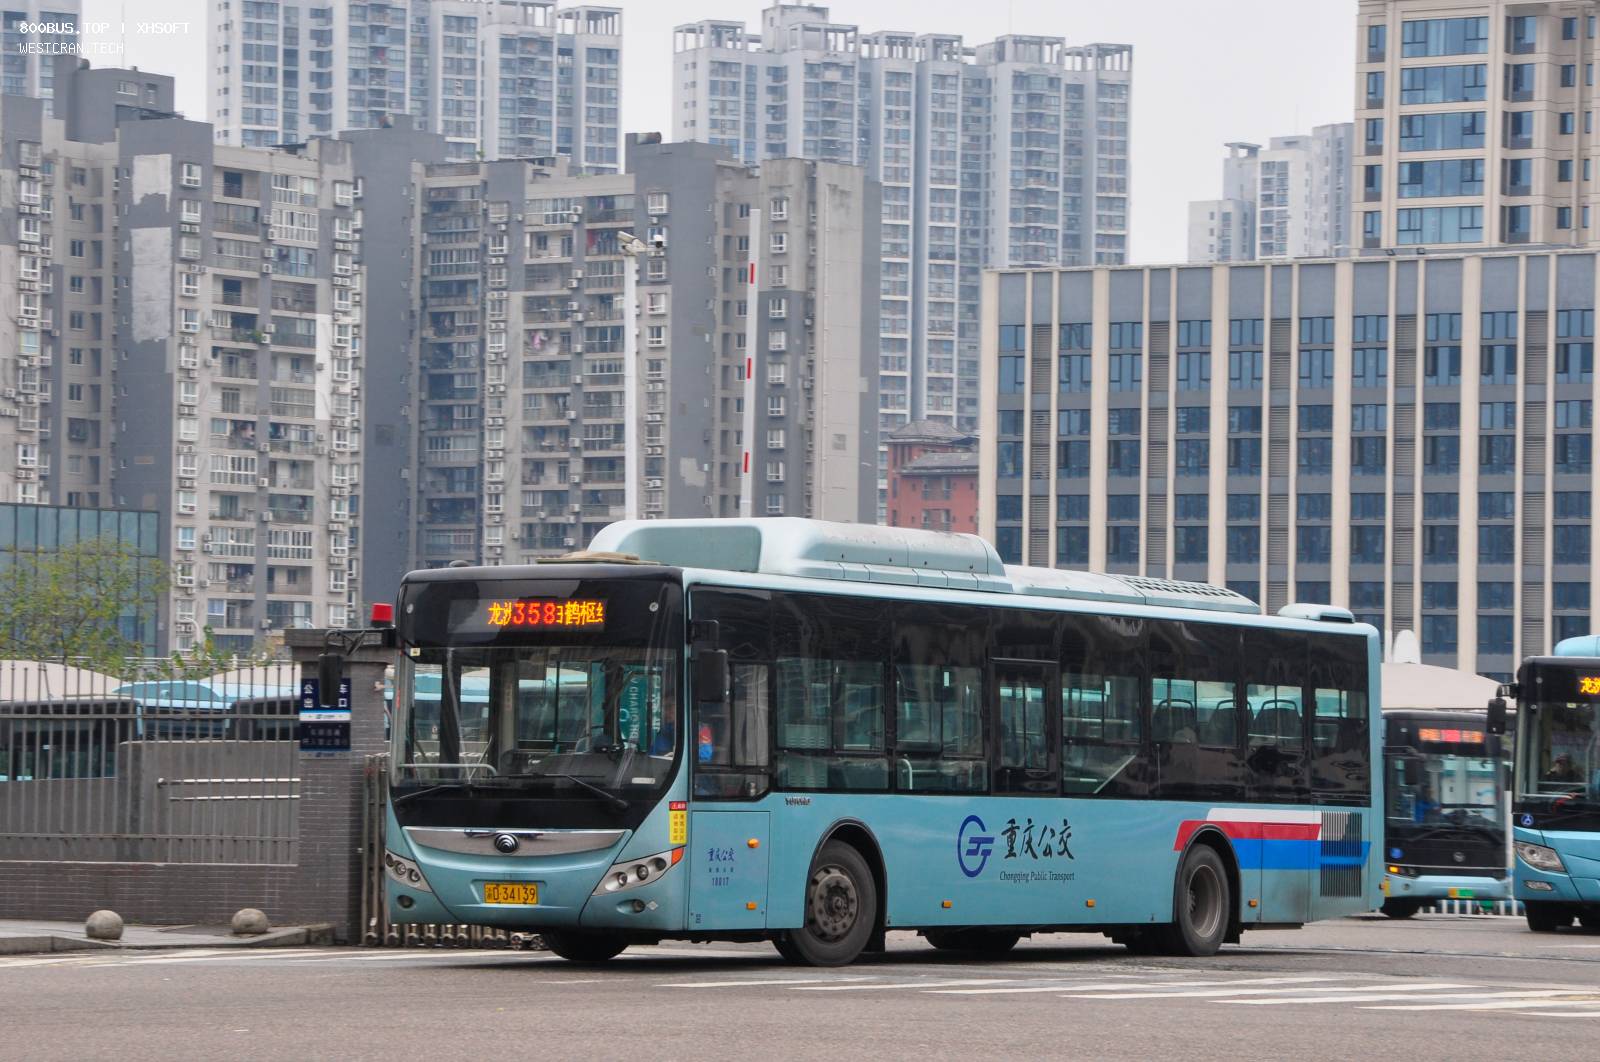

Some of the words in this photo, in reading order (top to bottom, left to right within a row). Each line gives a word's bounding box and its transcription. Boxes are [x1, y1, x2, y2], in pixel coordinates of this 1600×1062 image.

[512, 602, 556, 624] 358
[1001, 818, 1075, 860] 重庆公交
[1000, 870, 1029, 884] Chongqing
[1030, 871, 1048, 881] Public
[1048, 871, 1075, 884] Transport
